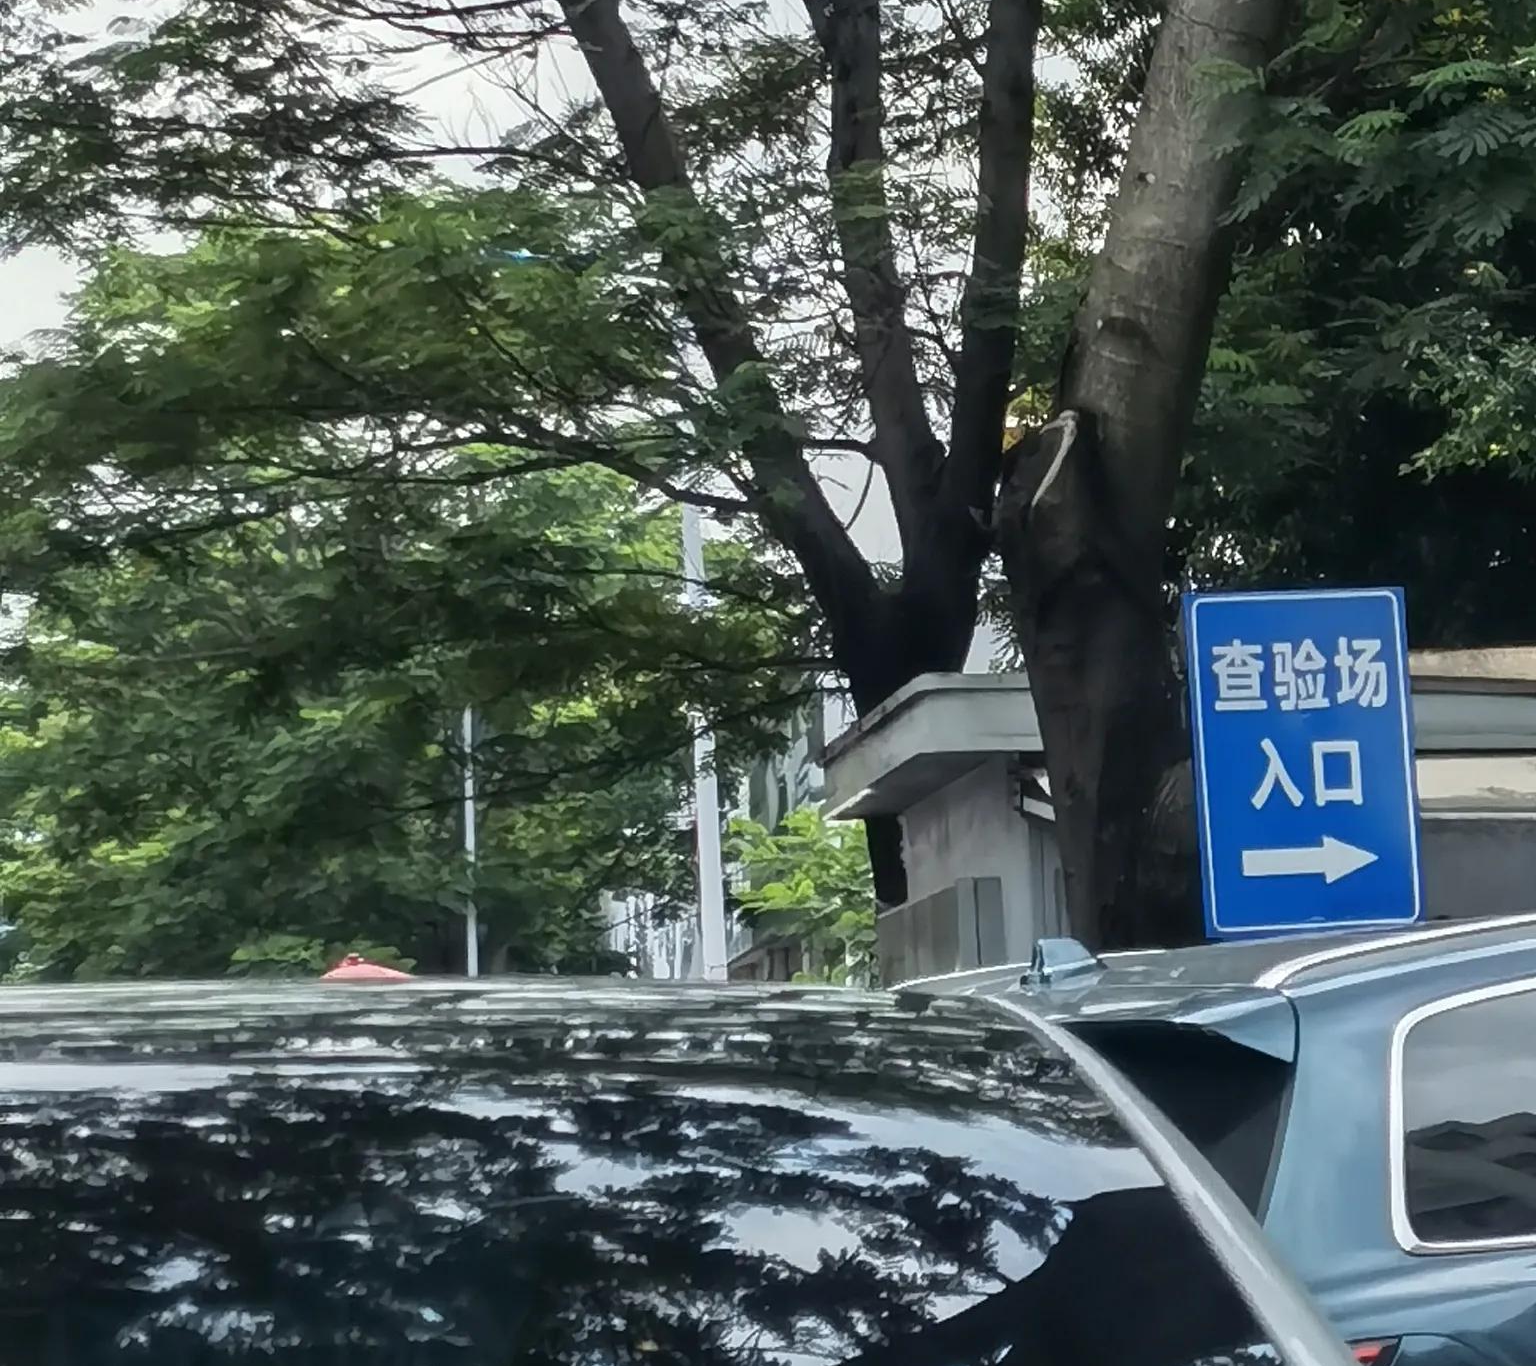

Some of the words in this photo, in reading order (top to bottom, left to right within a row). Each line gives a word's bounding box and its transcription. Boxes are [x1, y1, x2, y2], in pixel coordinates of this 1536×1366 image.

[1211, 636, 1388, 711] 查验场
[1250, 737, 1364, 810] 入口
